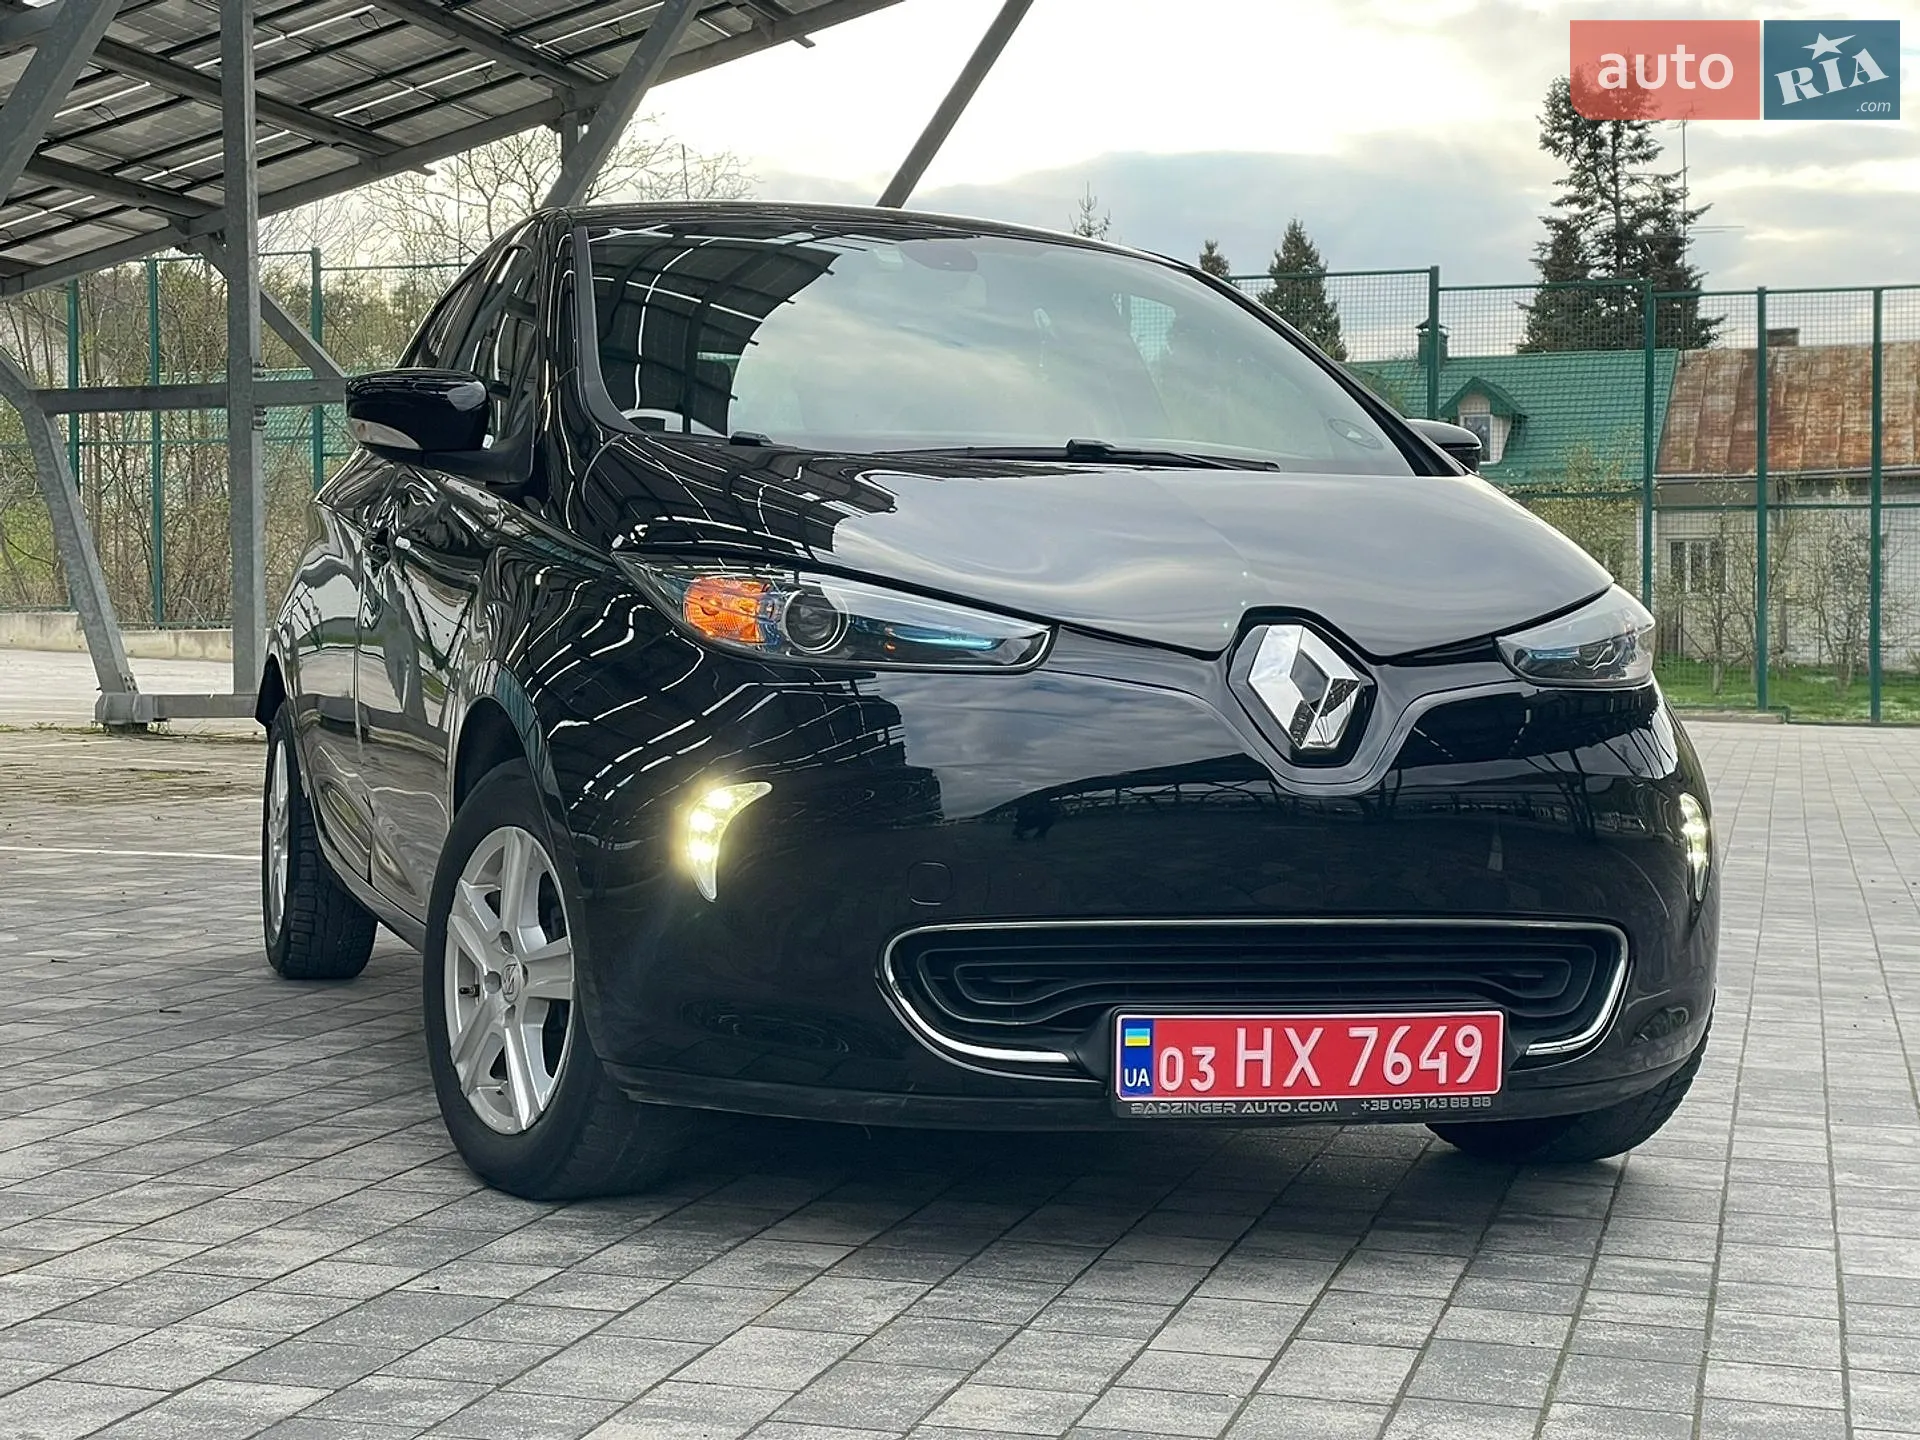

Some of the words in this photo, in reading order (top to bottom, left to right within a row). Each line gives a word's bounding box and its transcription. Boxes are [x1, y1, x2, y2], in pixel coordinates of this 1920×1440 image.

[1158, 1046, 1216, 1091] 03
[1235, 1026, 1324, 1088] HX
[1348, 1024, 1483, 1087] 7649
[1124, 1069, 1150, 1087] UA
[1361, 1100, 1389, 1110] +38
[1392, 1099, 1421, 1109] 095
[1425, 1098, 1447, 1109] 143
